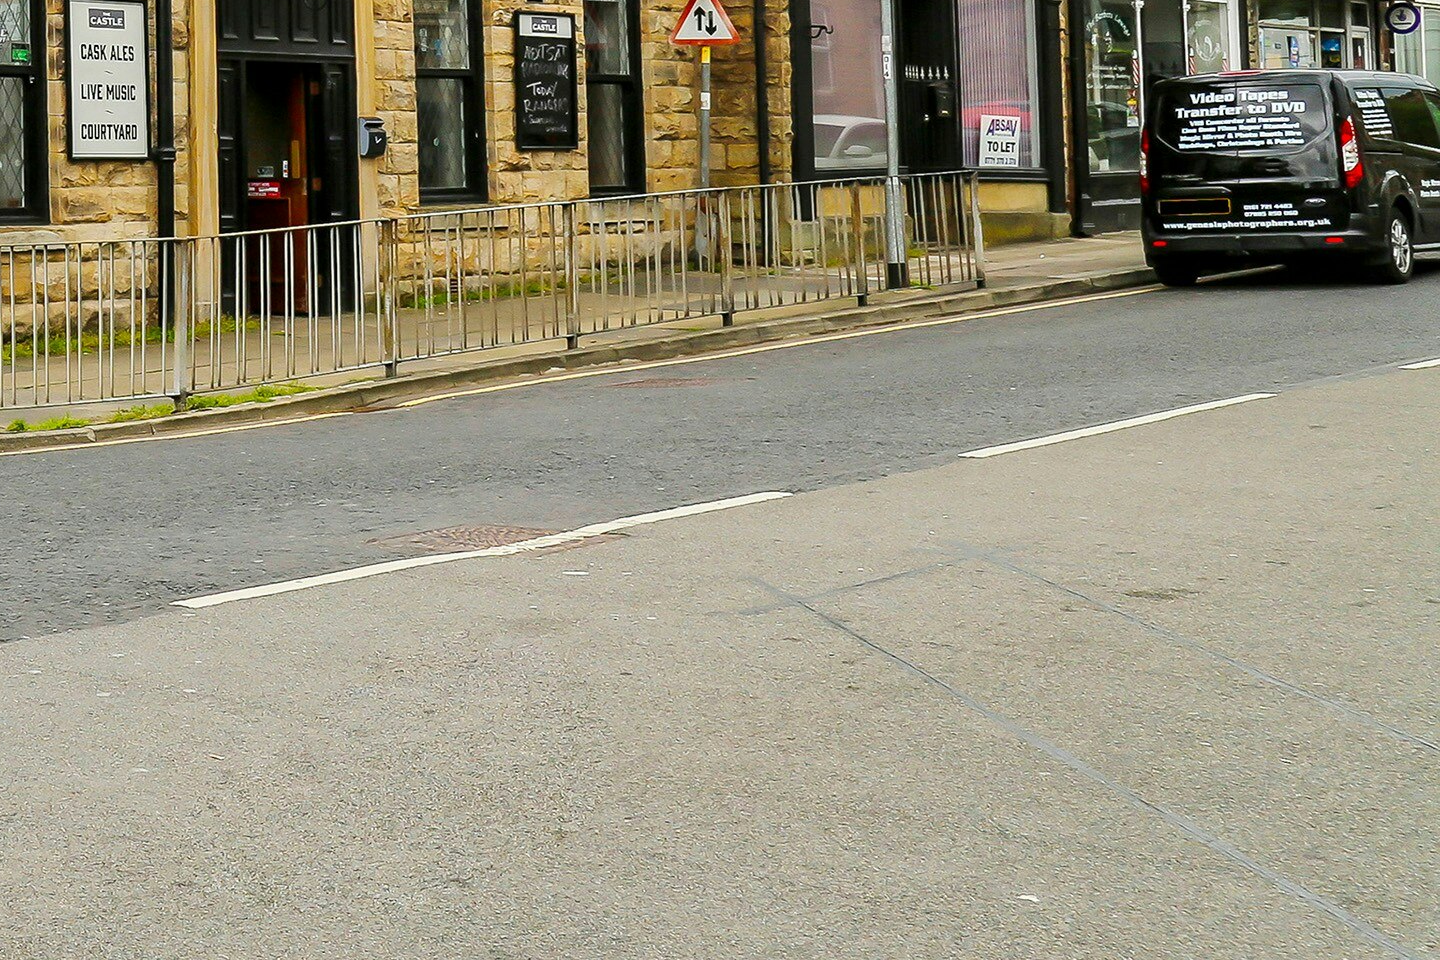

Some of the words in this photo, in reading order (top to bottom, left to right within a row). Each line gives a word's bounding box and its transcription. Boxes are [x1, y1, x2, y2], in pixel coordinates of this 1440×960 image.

[90, 17, 123, 26] CASTLE
[532, 23, 556, 32] CASTLE
[81, 44, 107, 60] CASK
[110, 45, 134, 61] ALES
[81, 84, 103, 100] LIVE
[105, 84, 136, 101] MUSIC
[526, 81, 558, 97] TODAY
[1190, 92, 1234, 104] Video
[1238, 90, 1289, 103] Tapes
[1175, 104, 1243, 119] Transfer
[1246, 103, 1267, 114] to
[1271, 101, 1306, 113] DVD
[81, 124, 137, 140] COURTYARD
[987, 141, 999, 152] TO
[1000, 141, 1016, 153] LET
[1163, 218, 1331, 230] www.genesisphotographers.org.uk
